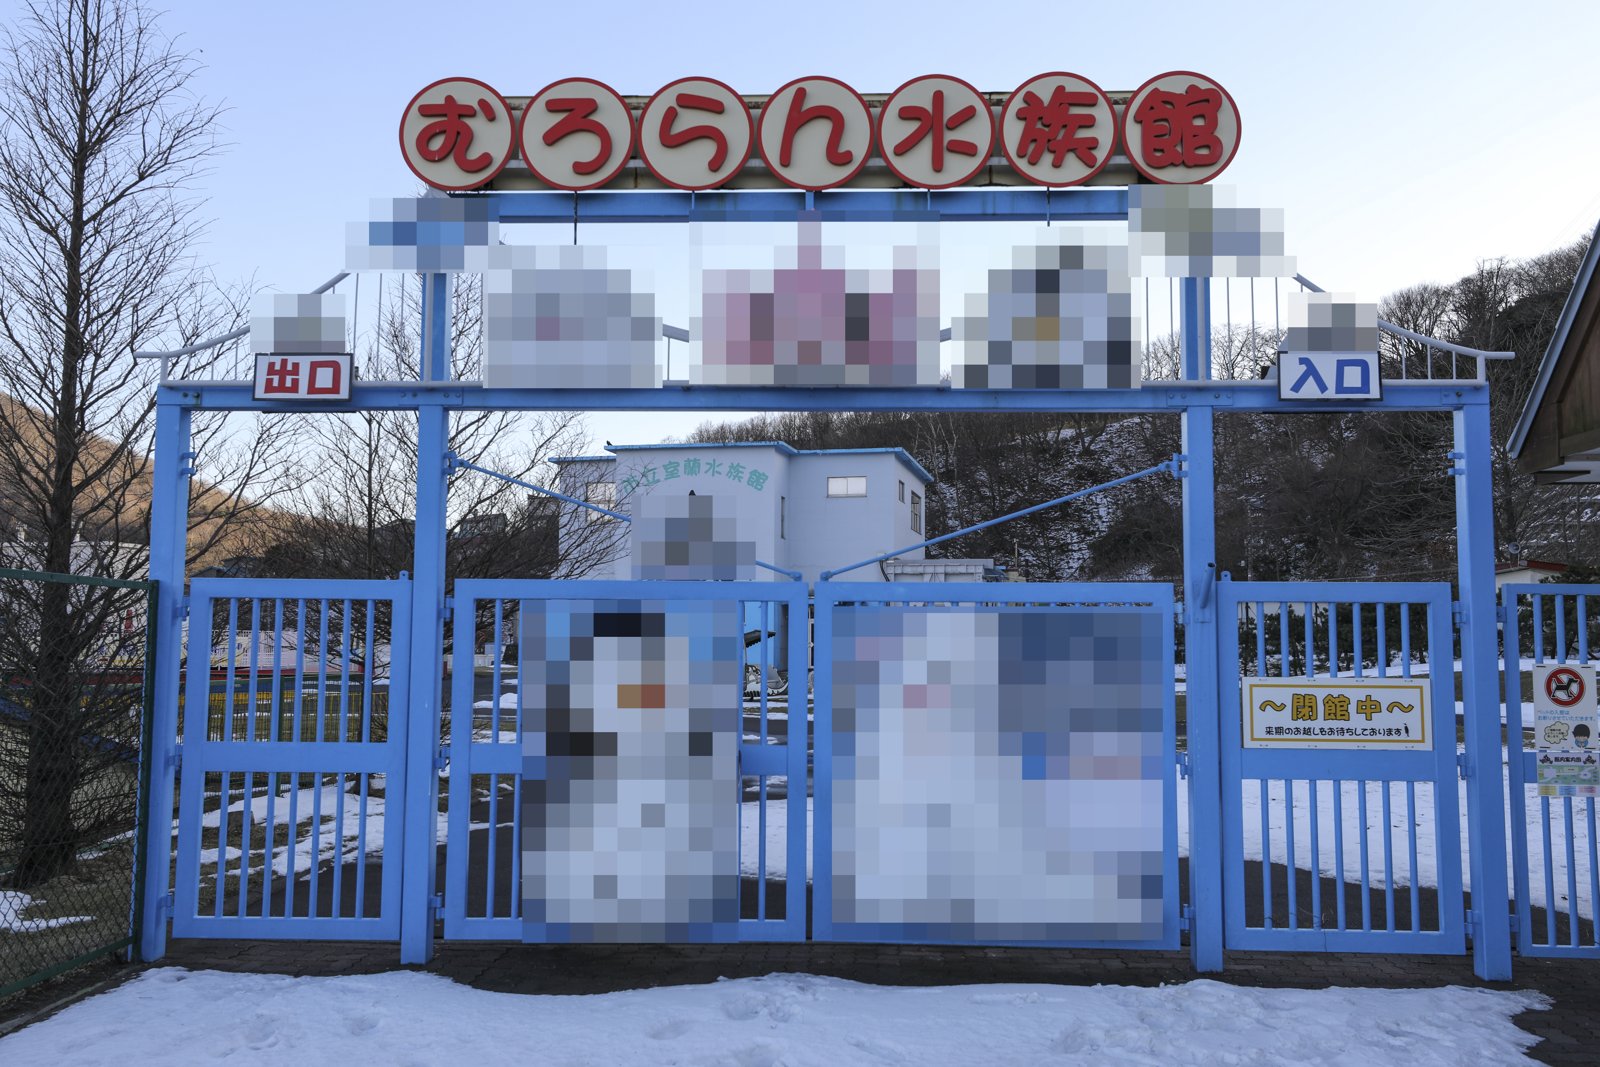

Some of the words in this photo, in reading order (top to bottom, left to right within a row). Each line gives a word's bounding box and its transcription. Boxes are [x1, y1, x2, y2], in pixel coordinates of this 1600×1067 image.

[416, 85, 1223, 175] むろらん水族館
[264, 358, 341, 395] 出口
[1290, 357, 1370, 395] 入口
[1265, 726, 1402, 738] 来期のお越しをお待ちしております
